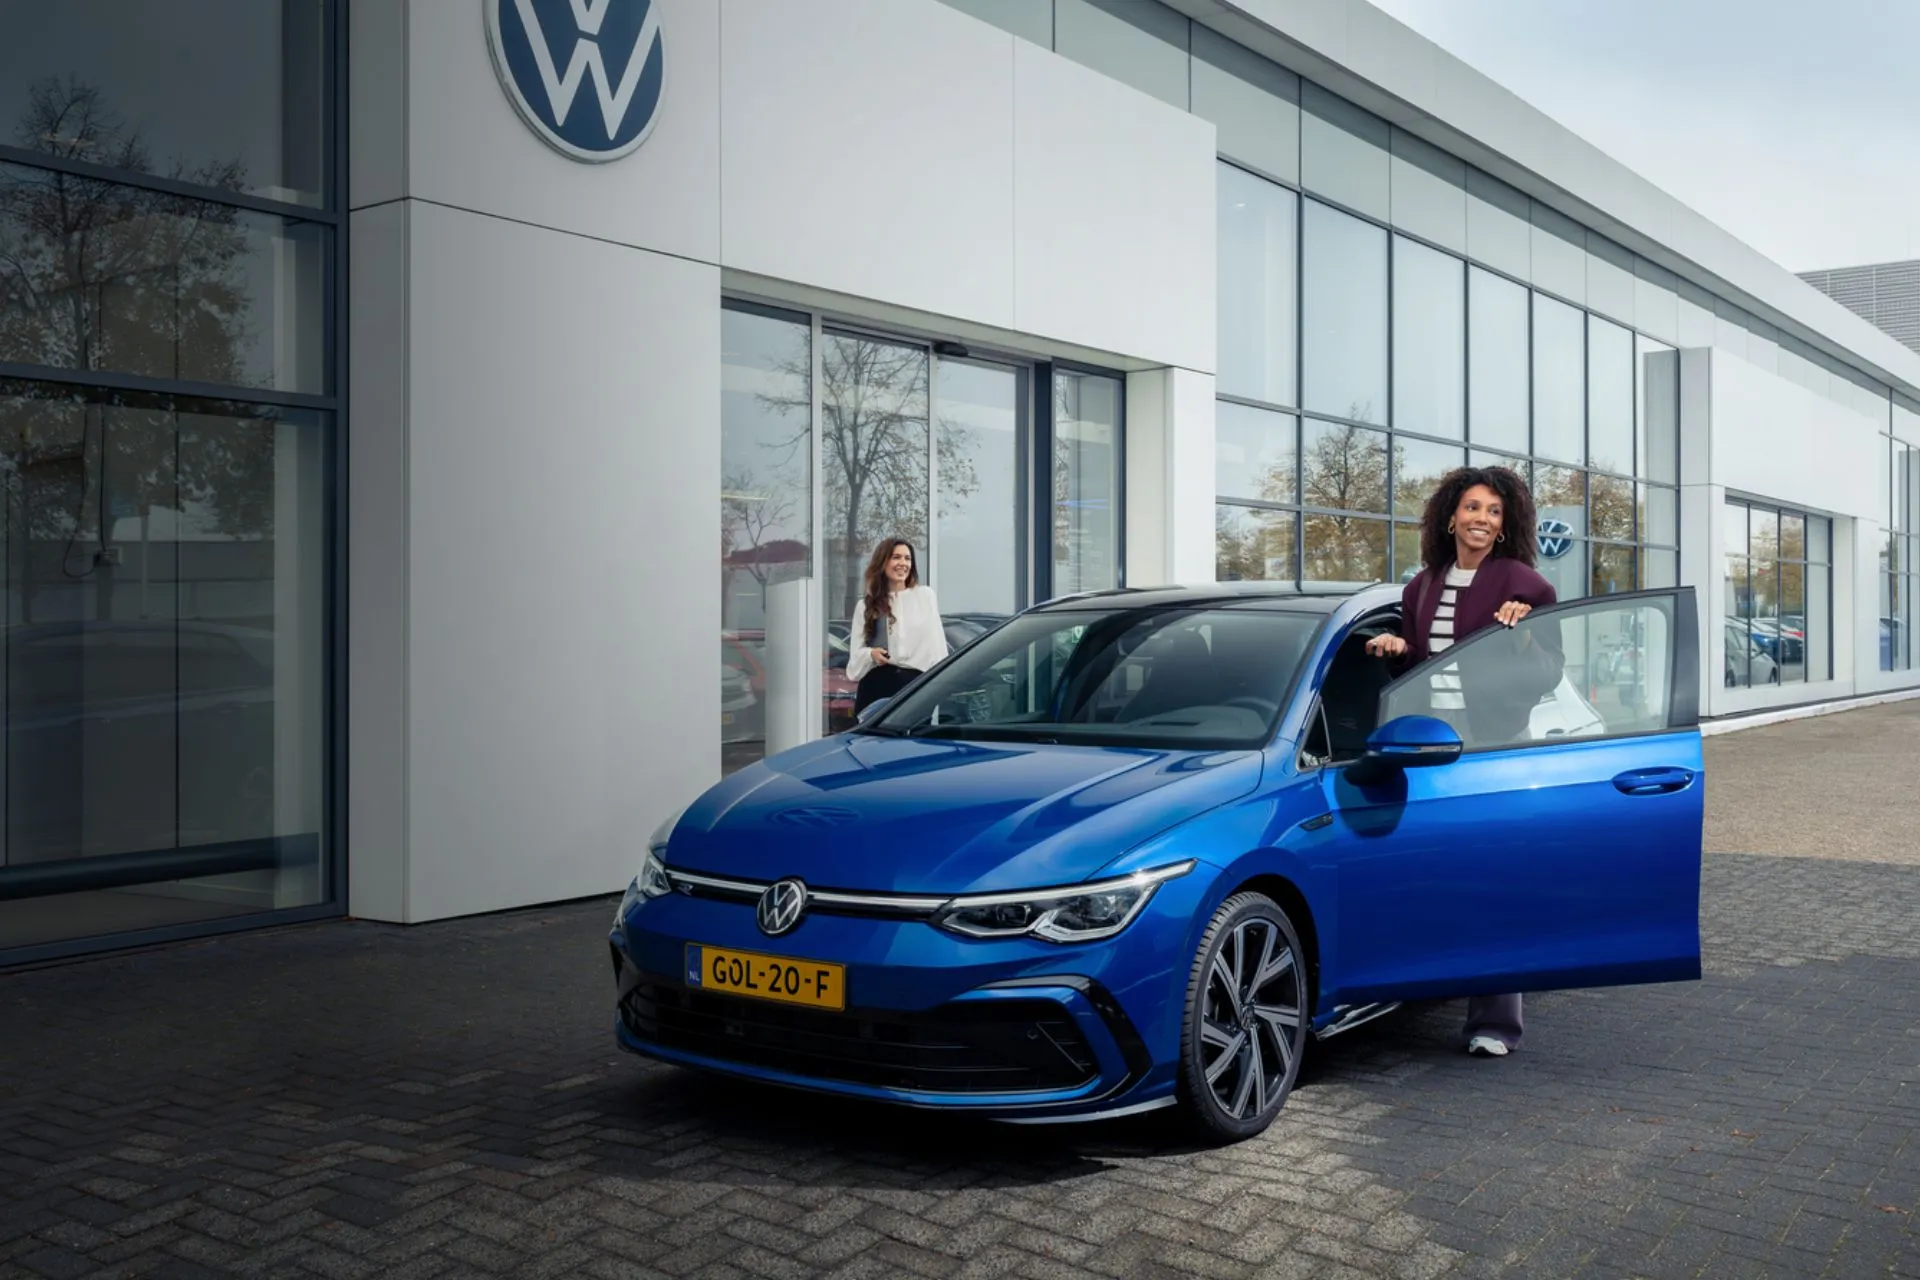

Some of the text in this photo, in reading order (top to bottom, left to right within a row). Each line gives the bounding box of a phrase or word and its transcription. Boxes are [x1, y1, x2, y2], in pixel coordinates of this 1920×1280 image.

[760, 880, 802, 931] VW
[689, 956, 830, 999] NL GOL-20-F
